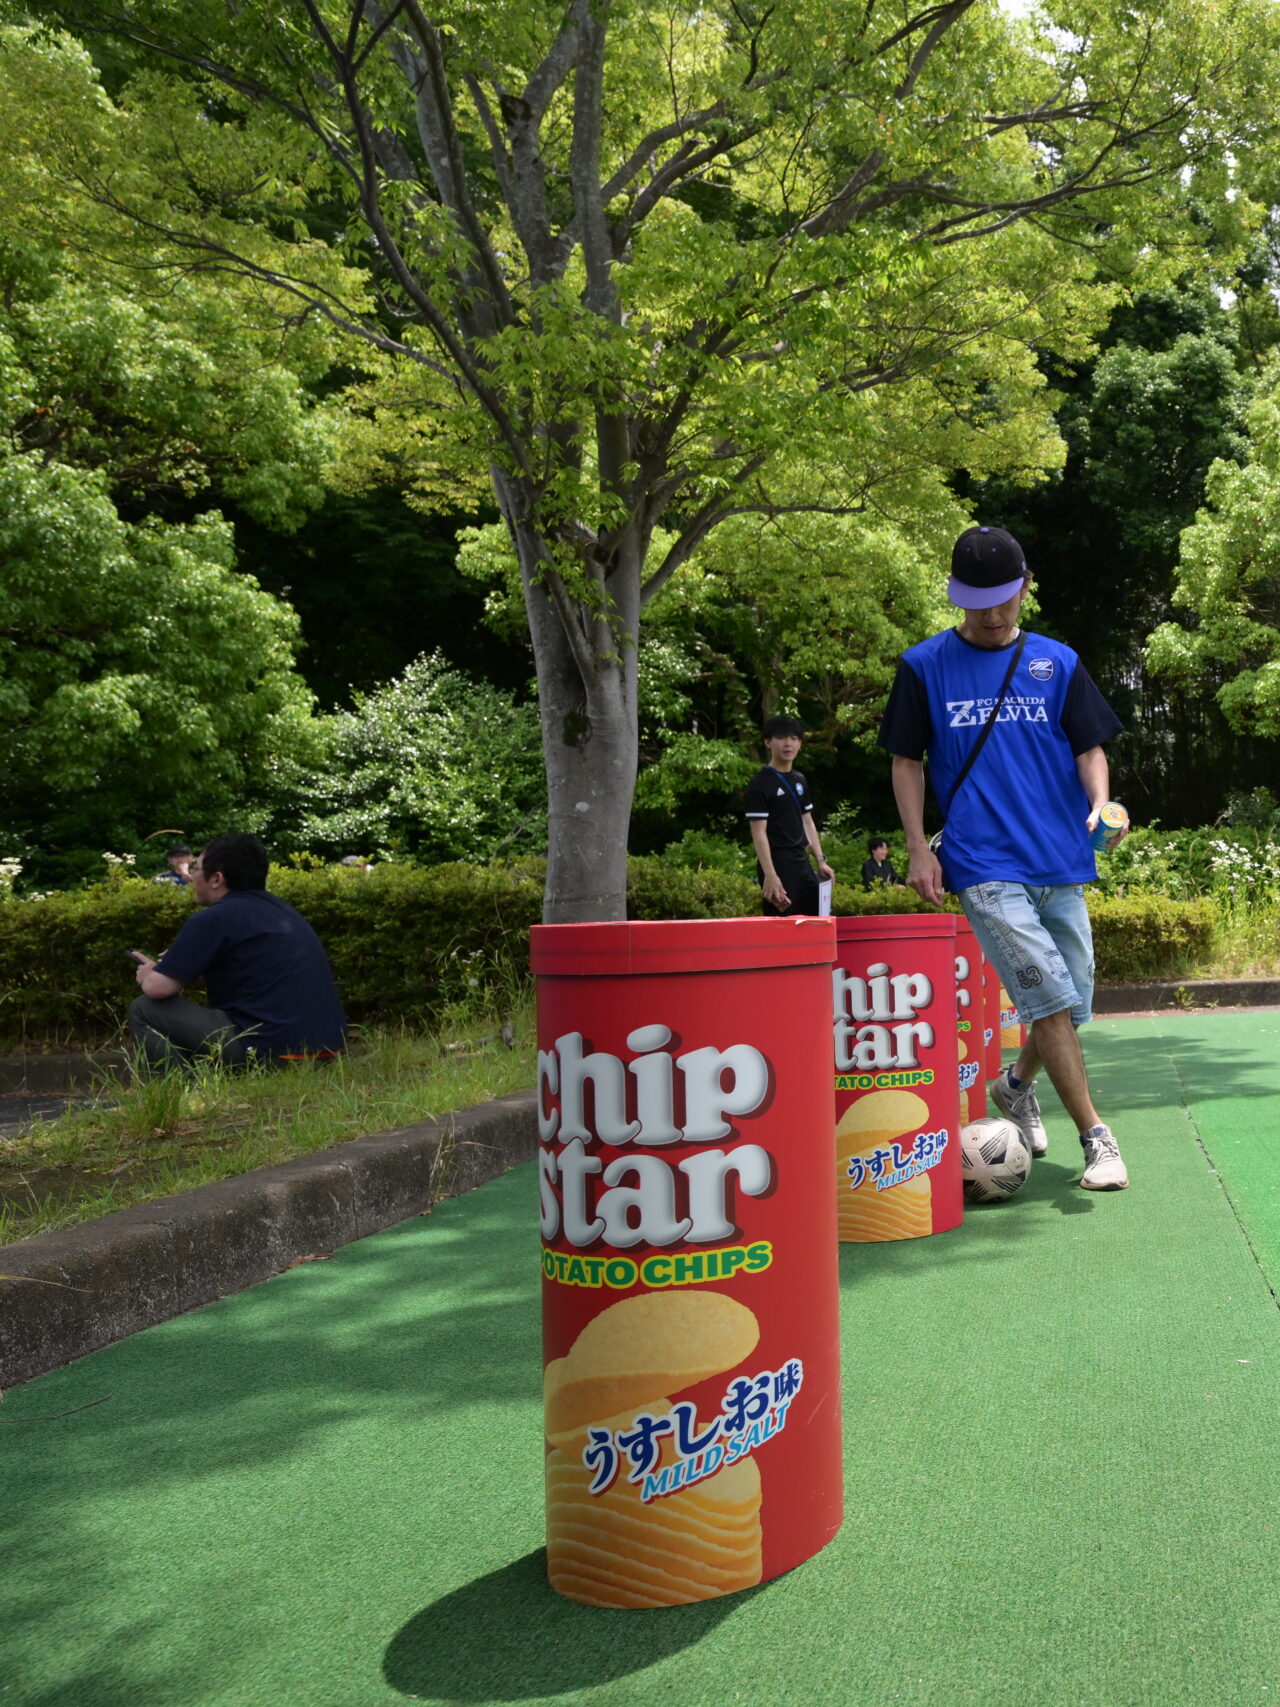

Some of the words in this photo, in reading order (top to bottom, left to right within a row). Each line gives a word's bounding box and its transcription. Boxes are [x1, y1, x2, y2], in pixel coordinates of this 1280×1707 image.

[976, 698, 993, 707] FC
[831, 962, 932, 1022] hip
[1016, 965, 1043, 989] 53
[833, 1018, 934, 1072] tar
[537, 1023, 769, 1146] chip
[834, 1074, 875, 1090] TATO
[875, 1068, 936, 1089] CHIPS
[847, 1129, 948, 1189] うすしお味
[876, 1165, 914, 1191] MILD
[914, 1150, 943, 1175] SALT
[539, 1137, 771, 1249] star
[541, 1250, 638, 1289] OTATO
[640, 1240, 773, 1288] CHIPS
[583, 1359, 803, 1493] うすしお味
[640, 1443, 723, 1502] MILD
[723, 1401, 791, 1464] SALT
